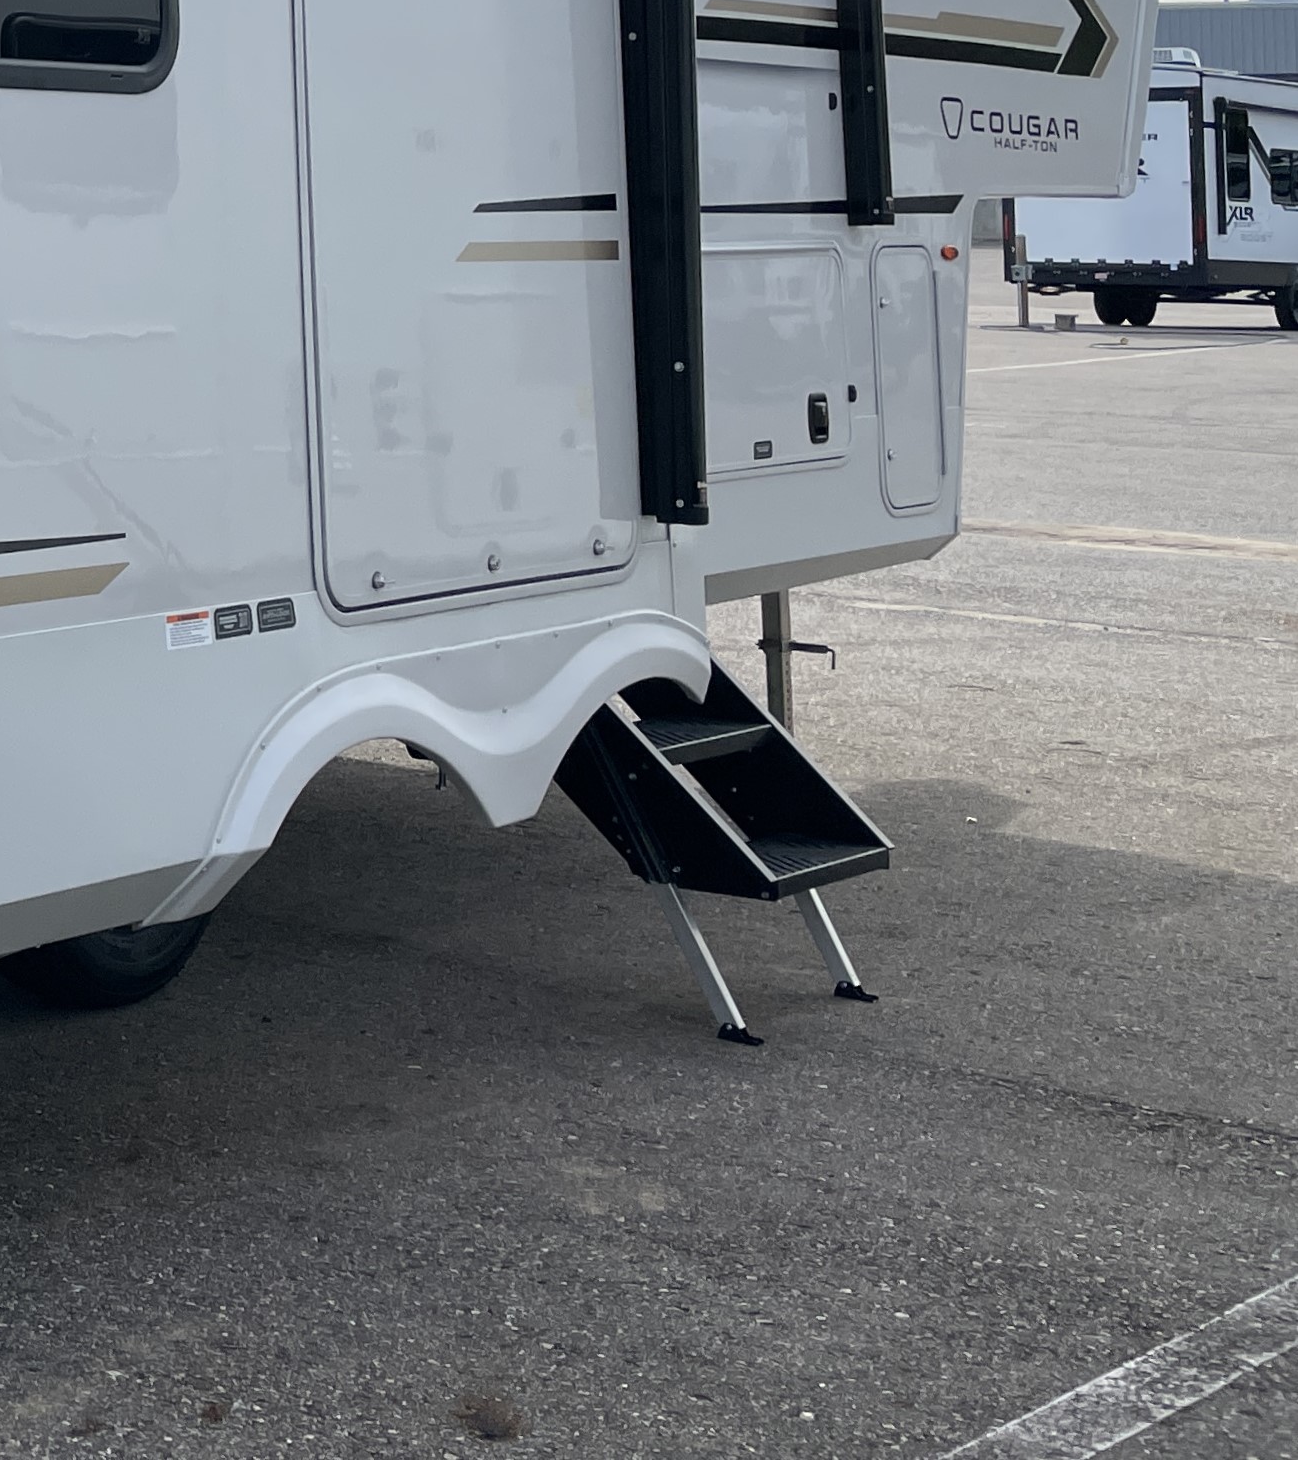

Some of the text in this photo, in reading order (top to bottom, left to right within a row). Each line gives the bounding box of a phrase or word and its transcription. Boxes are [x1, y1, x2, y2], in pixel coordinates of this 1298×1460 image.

[970, 109, 1079, 141] COUGAR
[994, 137, 1058, 153] HALF-TON
[1227, 206, 1254, 227] XLR
